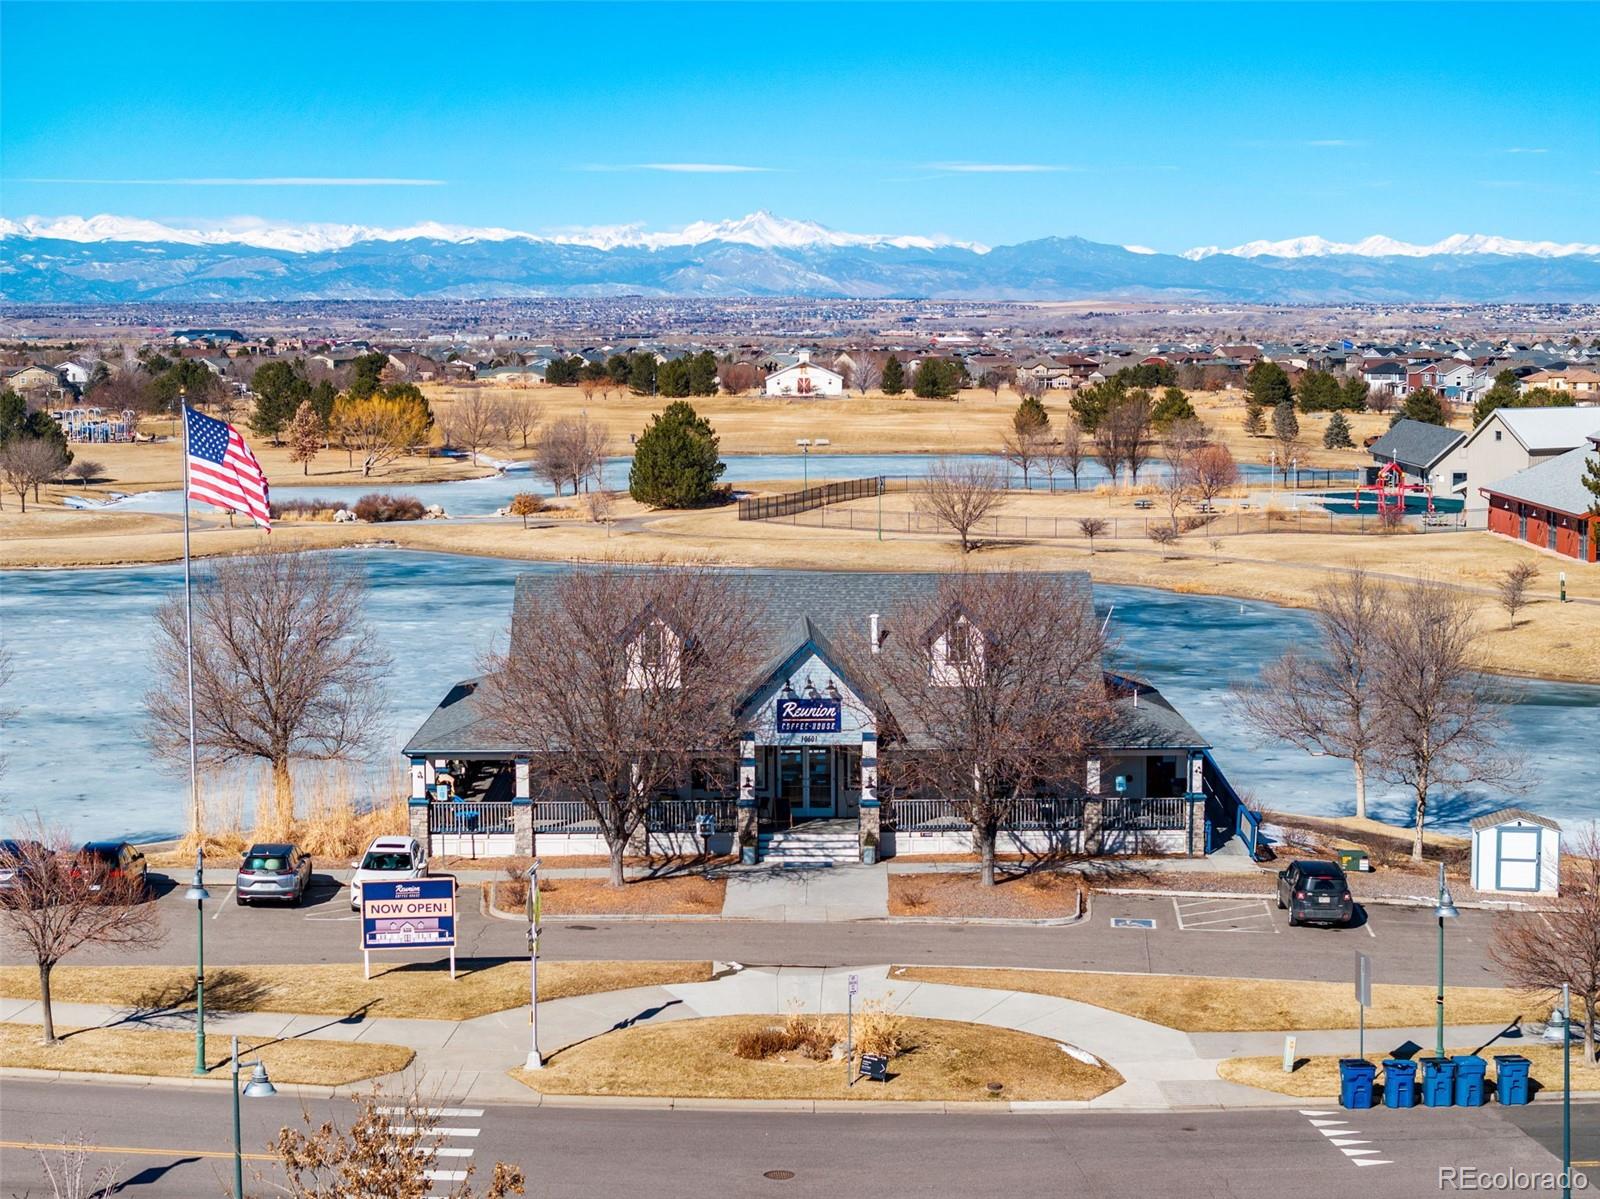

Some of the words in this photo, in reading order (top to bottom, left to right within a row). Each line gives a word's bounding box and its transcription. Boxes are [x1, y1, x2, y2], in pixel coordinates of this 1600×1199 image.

[782, 702, 837, 717] Reunion
[395, 884, 420, 892] Reunion
[371, 903, 403, 914] NOW
[407, 903, 447, 913] OPEN!
